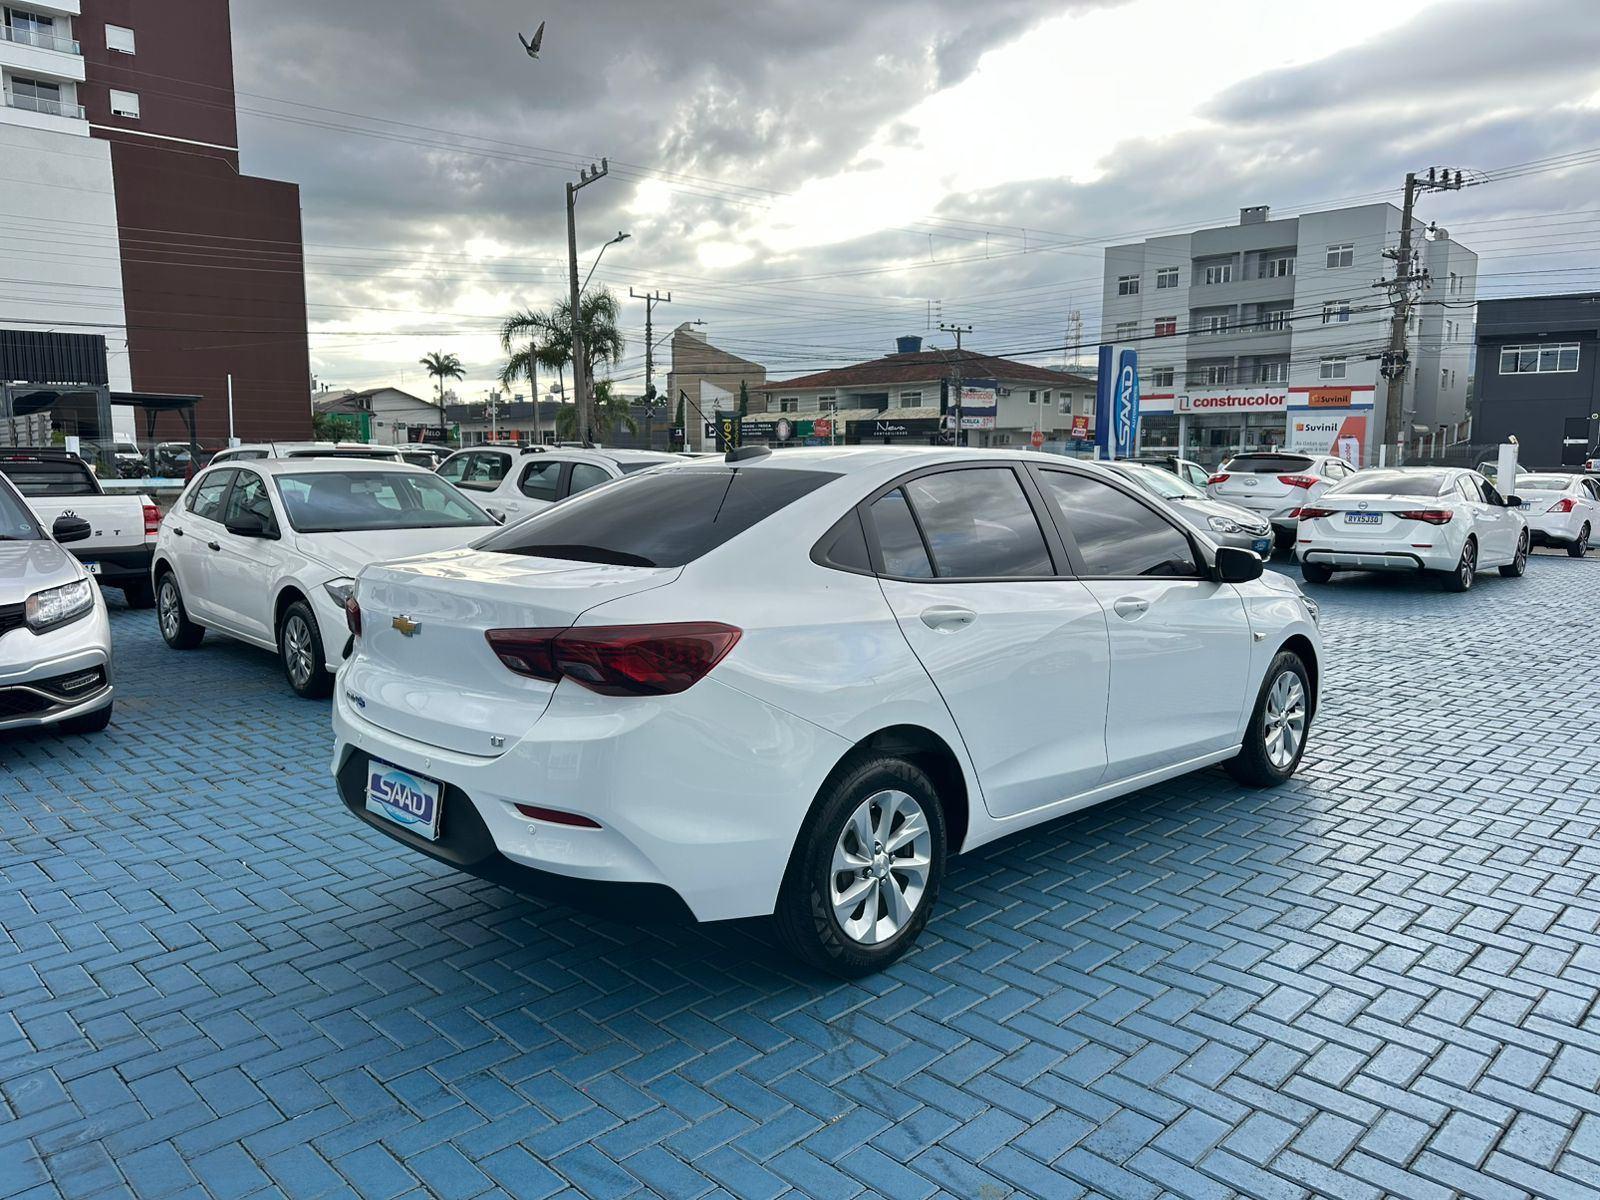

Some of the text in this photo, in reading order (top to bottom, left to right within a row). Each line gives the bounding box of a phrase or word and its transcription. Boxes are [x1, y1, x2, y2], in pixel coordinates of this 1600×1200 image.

[1193, 393, 1286, 408] construcolor
[1320, 395, 1348, 403] Suvinil
[1119, 365, 1133, 458] SAAD
[1305, 423, 1338, 432] Suvinil
[370, 776, 426, 816] SAAD
